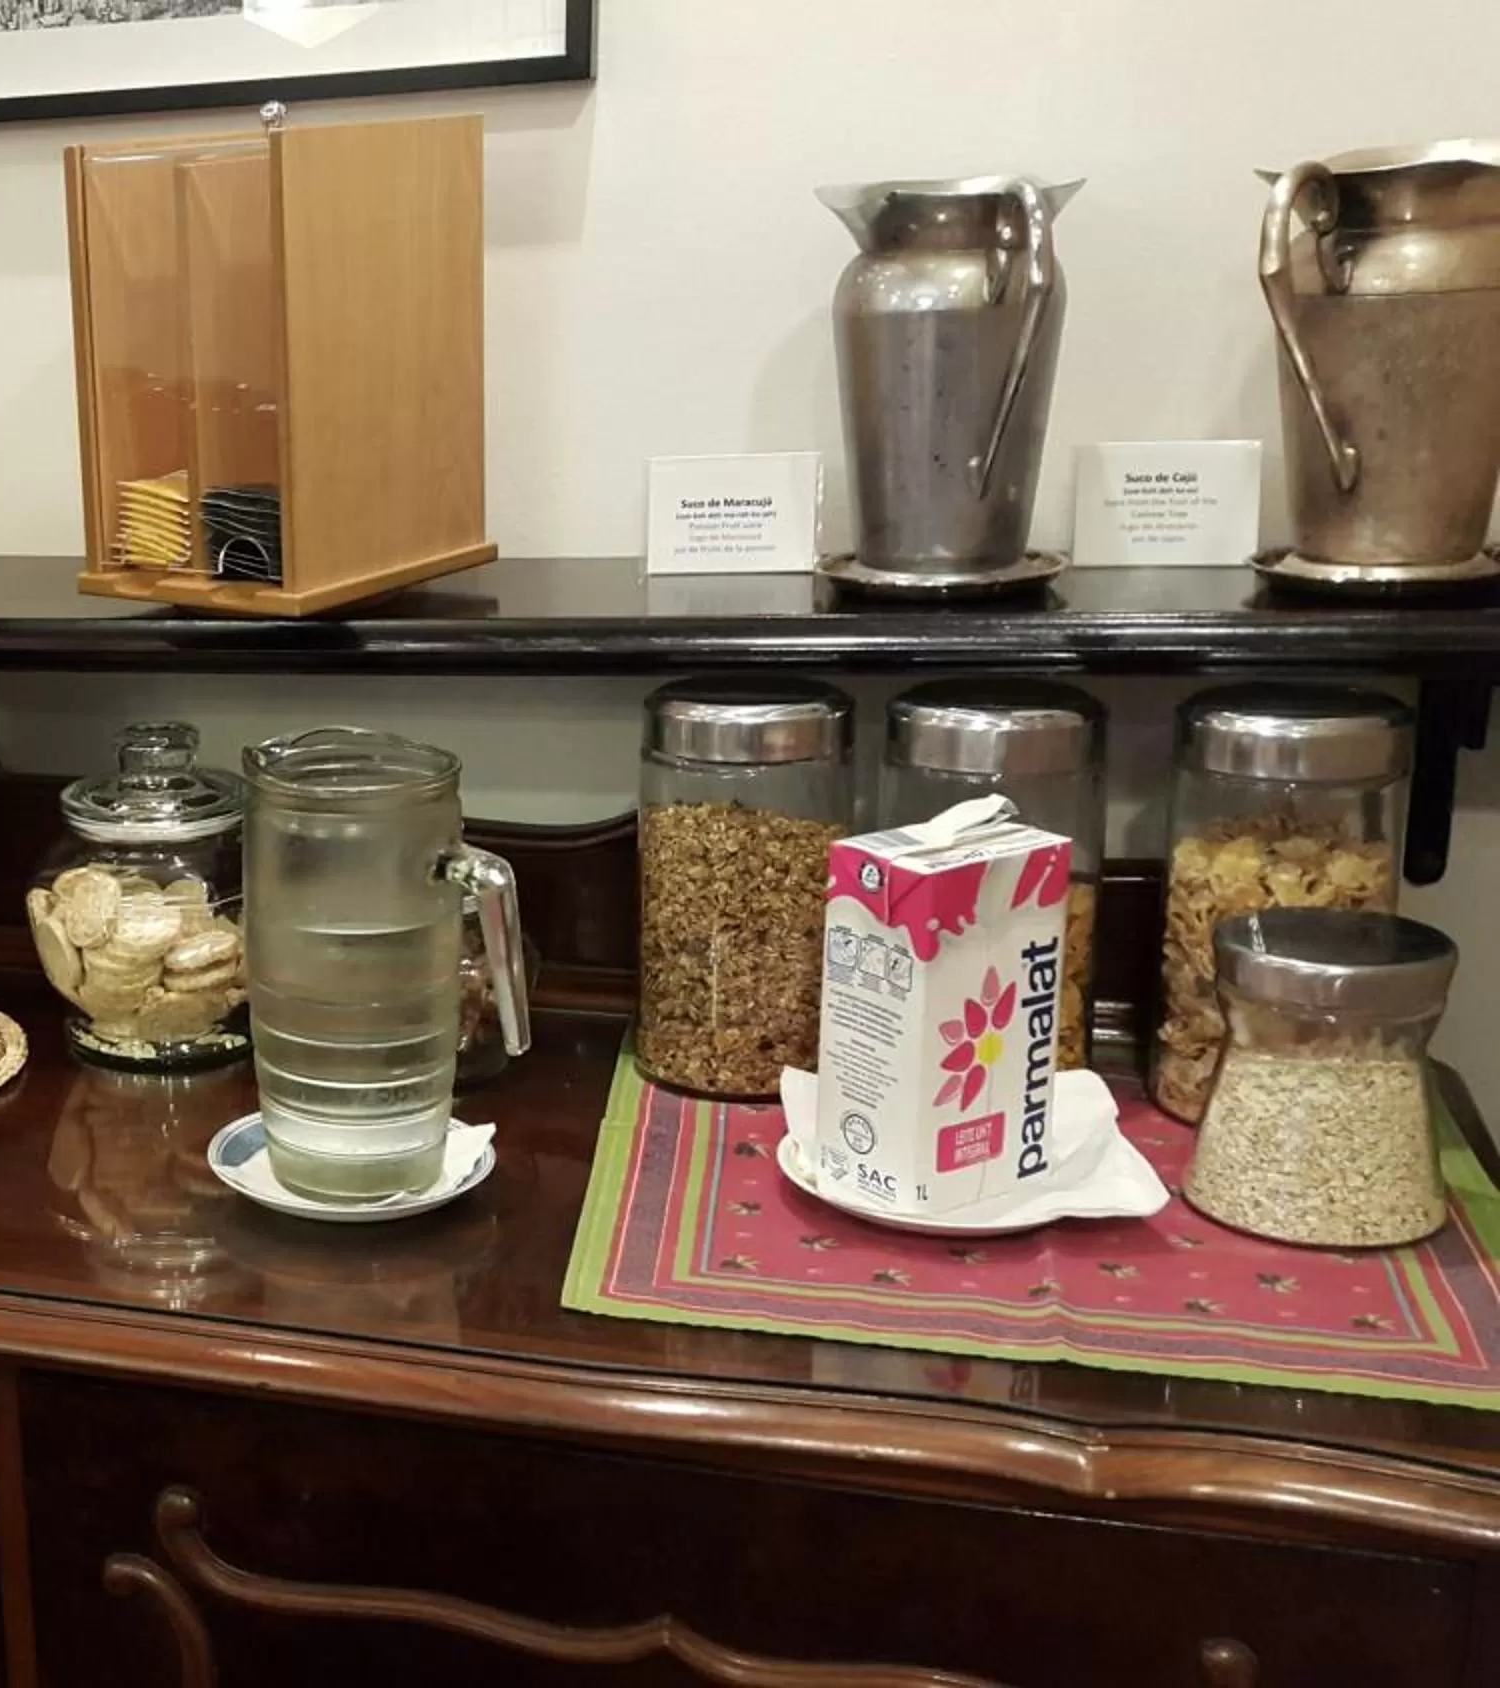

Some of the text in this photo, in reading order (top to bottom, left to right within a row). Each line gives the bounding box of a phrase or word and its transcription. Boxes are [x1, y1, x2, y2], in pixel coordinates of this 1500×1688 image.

[1124, 472, 1152, 484] Suco
[1156, 472, 1170, 483] de
[681, 496, 773, 509] Suco de Maracujá
[1017, 936, 1059, 1179] parmalat
[857, 1163, 898, 1192] SAC
